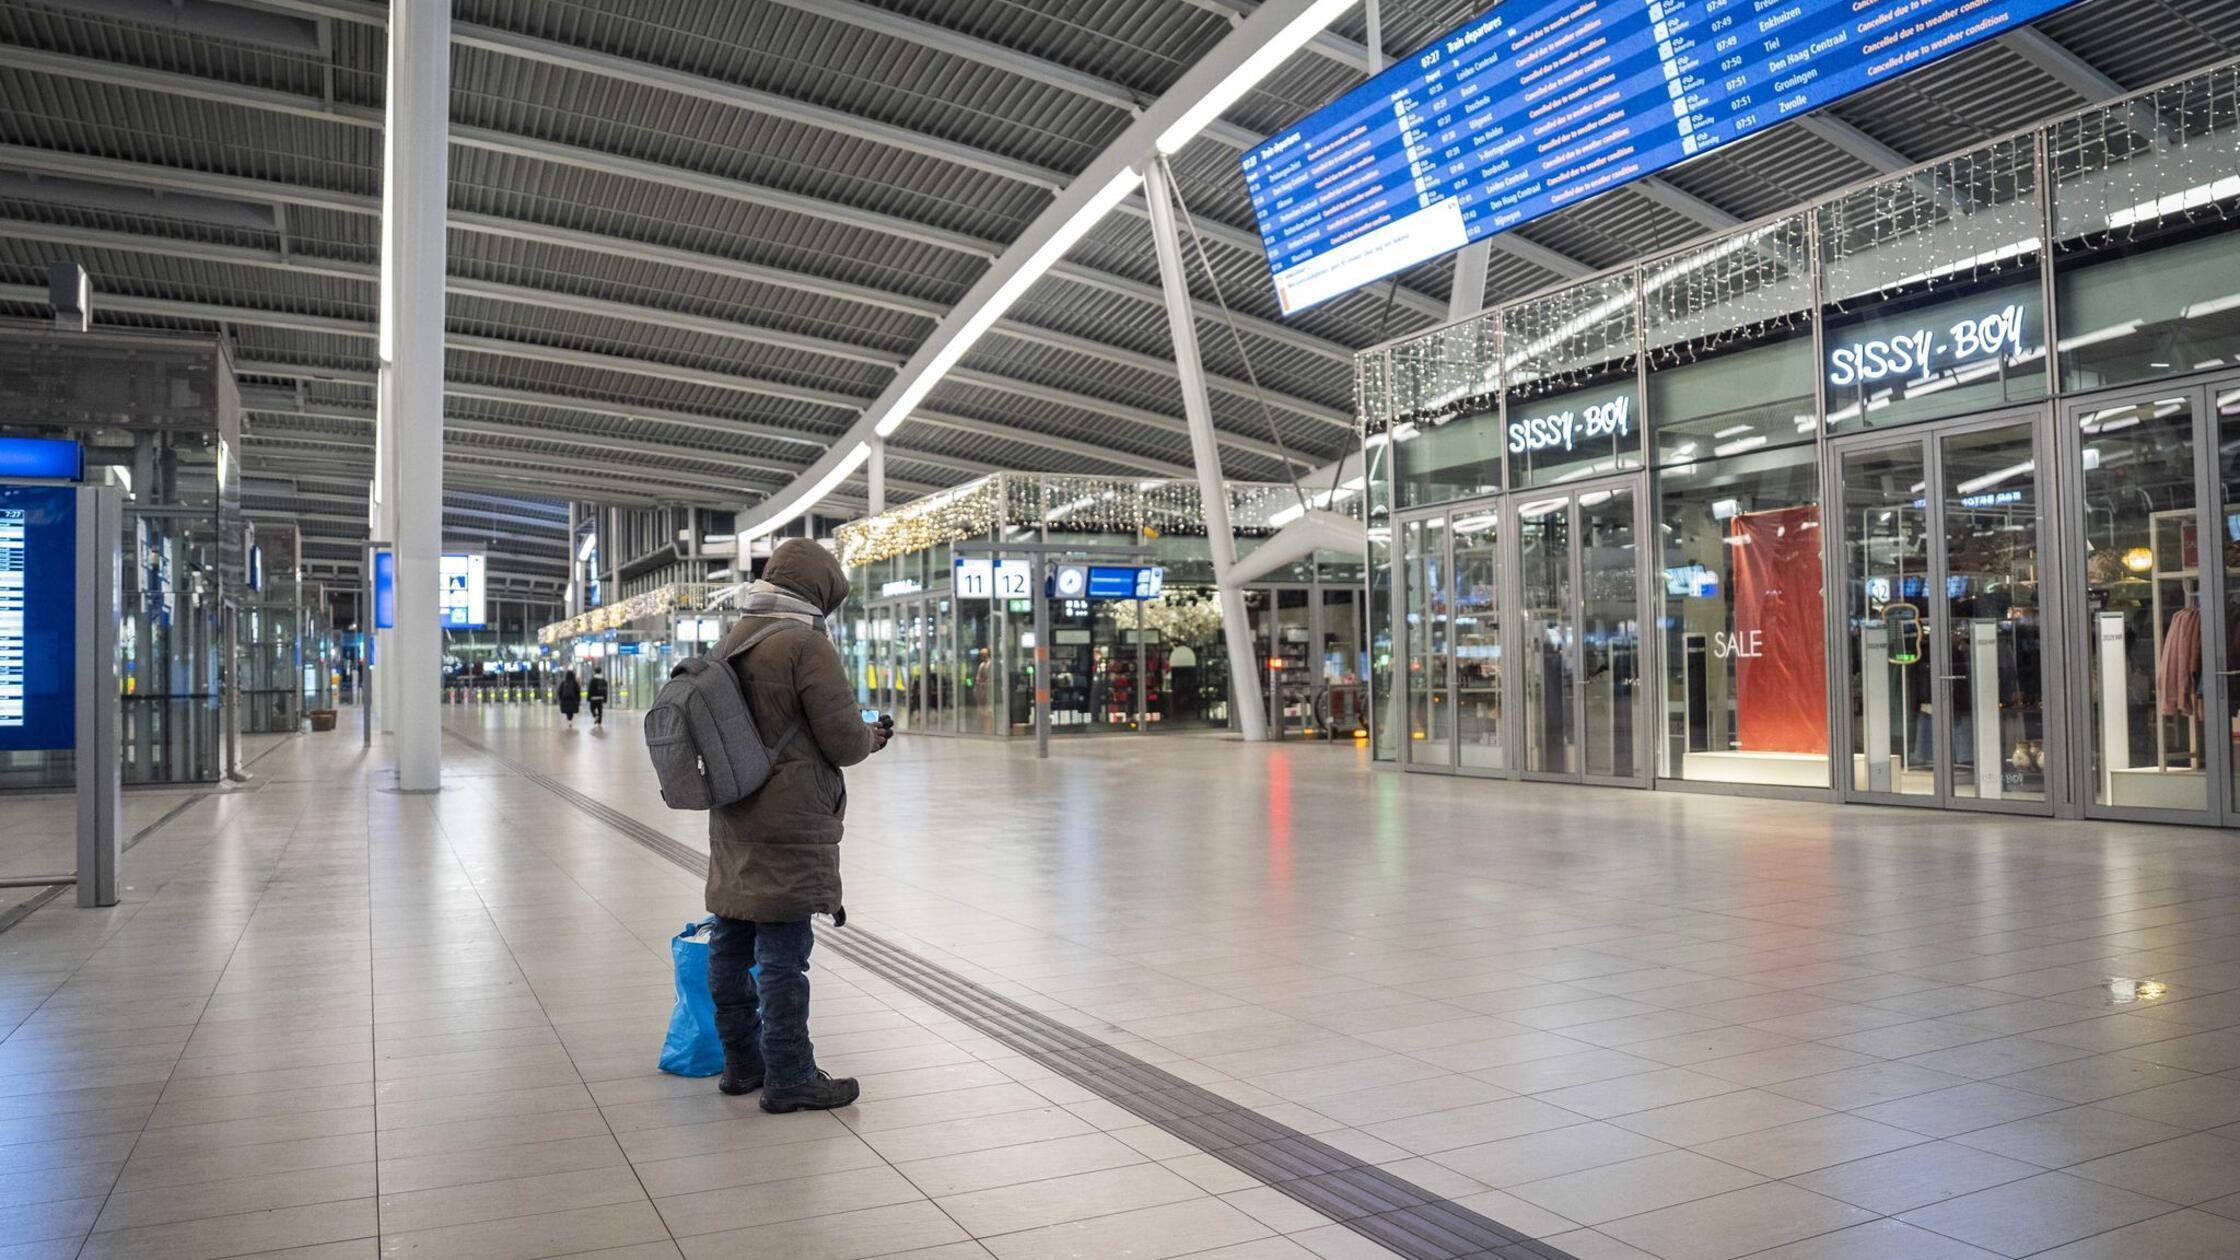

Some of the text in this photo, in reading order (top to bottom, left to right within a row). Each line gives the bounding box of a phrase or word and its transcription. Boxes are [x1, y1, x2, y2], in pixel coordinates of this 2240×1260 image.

[1421, 17, 1502, 68] 07:27 Train departures
[1474, 52, 1498, 71] Centraal
[1511, 33, 1535, 50] Cancelled
[1549, 15, 1570, 30] weather
[1570, 1, 1596, 19] conditions
[1516, 51, 1539, 67] Cancelled
[1554, 33, 1575, 48] weather
[1575, 19, 1601, 37] conditions
[1712, 16, 1732, 32] 07:49
[1717, 7, 1801, 51] 07:49 Enkhuizen
[1520, 67, 1544, 84] Cancelled
[1559, 51, 1579, 65] weather
[1579, 37, 1606, 55] conditions
[1721, 56, 1741, 71] 07:50
[1764, 37, 1780, 52] Tiel
[1726, 76, 1746, 90] 07:51
[1769, 59, 1787, 72] Den
[1787, 49, 1810, 64] Haag
[1810, 30, 1847, 54] Centraal
[1858, 10, 1893, 33] Cancelled
[1731, 95, 1751, 110] 07:51
[1774, 69, 1818, 92] Groningen
[1863, 32, 1898, 54] Cancelled
[1899, 28, 1914, 39] due
[1915, 23, 1925, 32] to
[1925, 8, 1958, 28] weather
[1736, 12, 2008, 129] 07:51 Zwolle Cancelled due to weather conditions
[1525, 85, 1548, 101] Cancelled
[1563, 68, 1584, 83] weather
[1584, 56, 1611, 73] conditions
[1529, 102, 1552, 118] Cancelled
[1568, 86, 1589, 100] weather
[1589, 74, 1615, 90] conditions
[1534, 120, 1557, 135] Cancelled
[1572, 104, 1593, 118] weather
[1593, 92, 1620, 108] conditions
[1538, 136, 1562, 152] Cancelled
[1577, 122, 1597, 136] weather
[1598, 110, 1625, 126] conditions
[1504, 169, 1529, 186] Centraal
[1542, 154, 1566, 169] Cancelled
[1581, 140, 1602, 153] weather
[1602, 128, 1629, 144] conditions
[1517, 183, 1541, 199] Centraal
[1547, 171, 1570, 186] Cancelled
[1586, 157, 1607, 170] weather
[1607, 146, 1634, 162] conditions
[1551, 188, 1575, 203] Cancelled
[1590, 175, 1612, 188] weather
[1612, 164, 1639, 179] conditions
[1831, 304, 2024, 385] SISSY-BOY
[1509, 396, 1629, 453] SISSY-BOY
[964, 573, 982, 594] 11
[1002, 573, 1025, 594] 12
[1713, 629, 1763, 658] SALE
